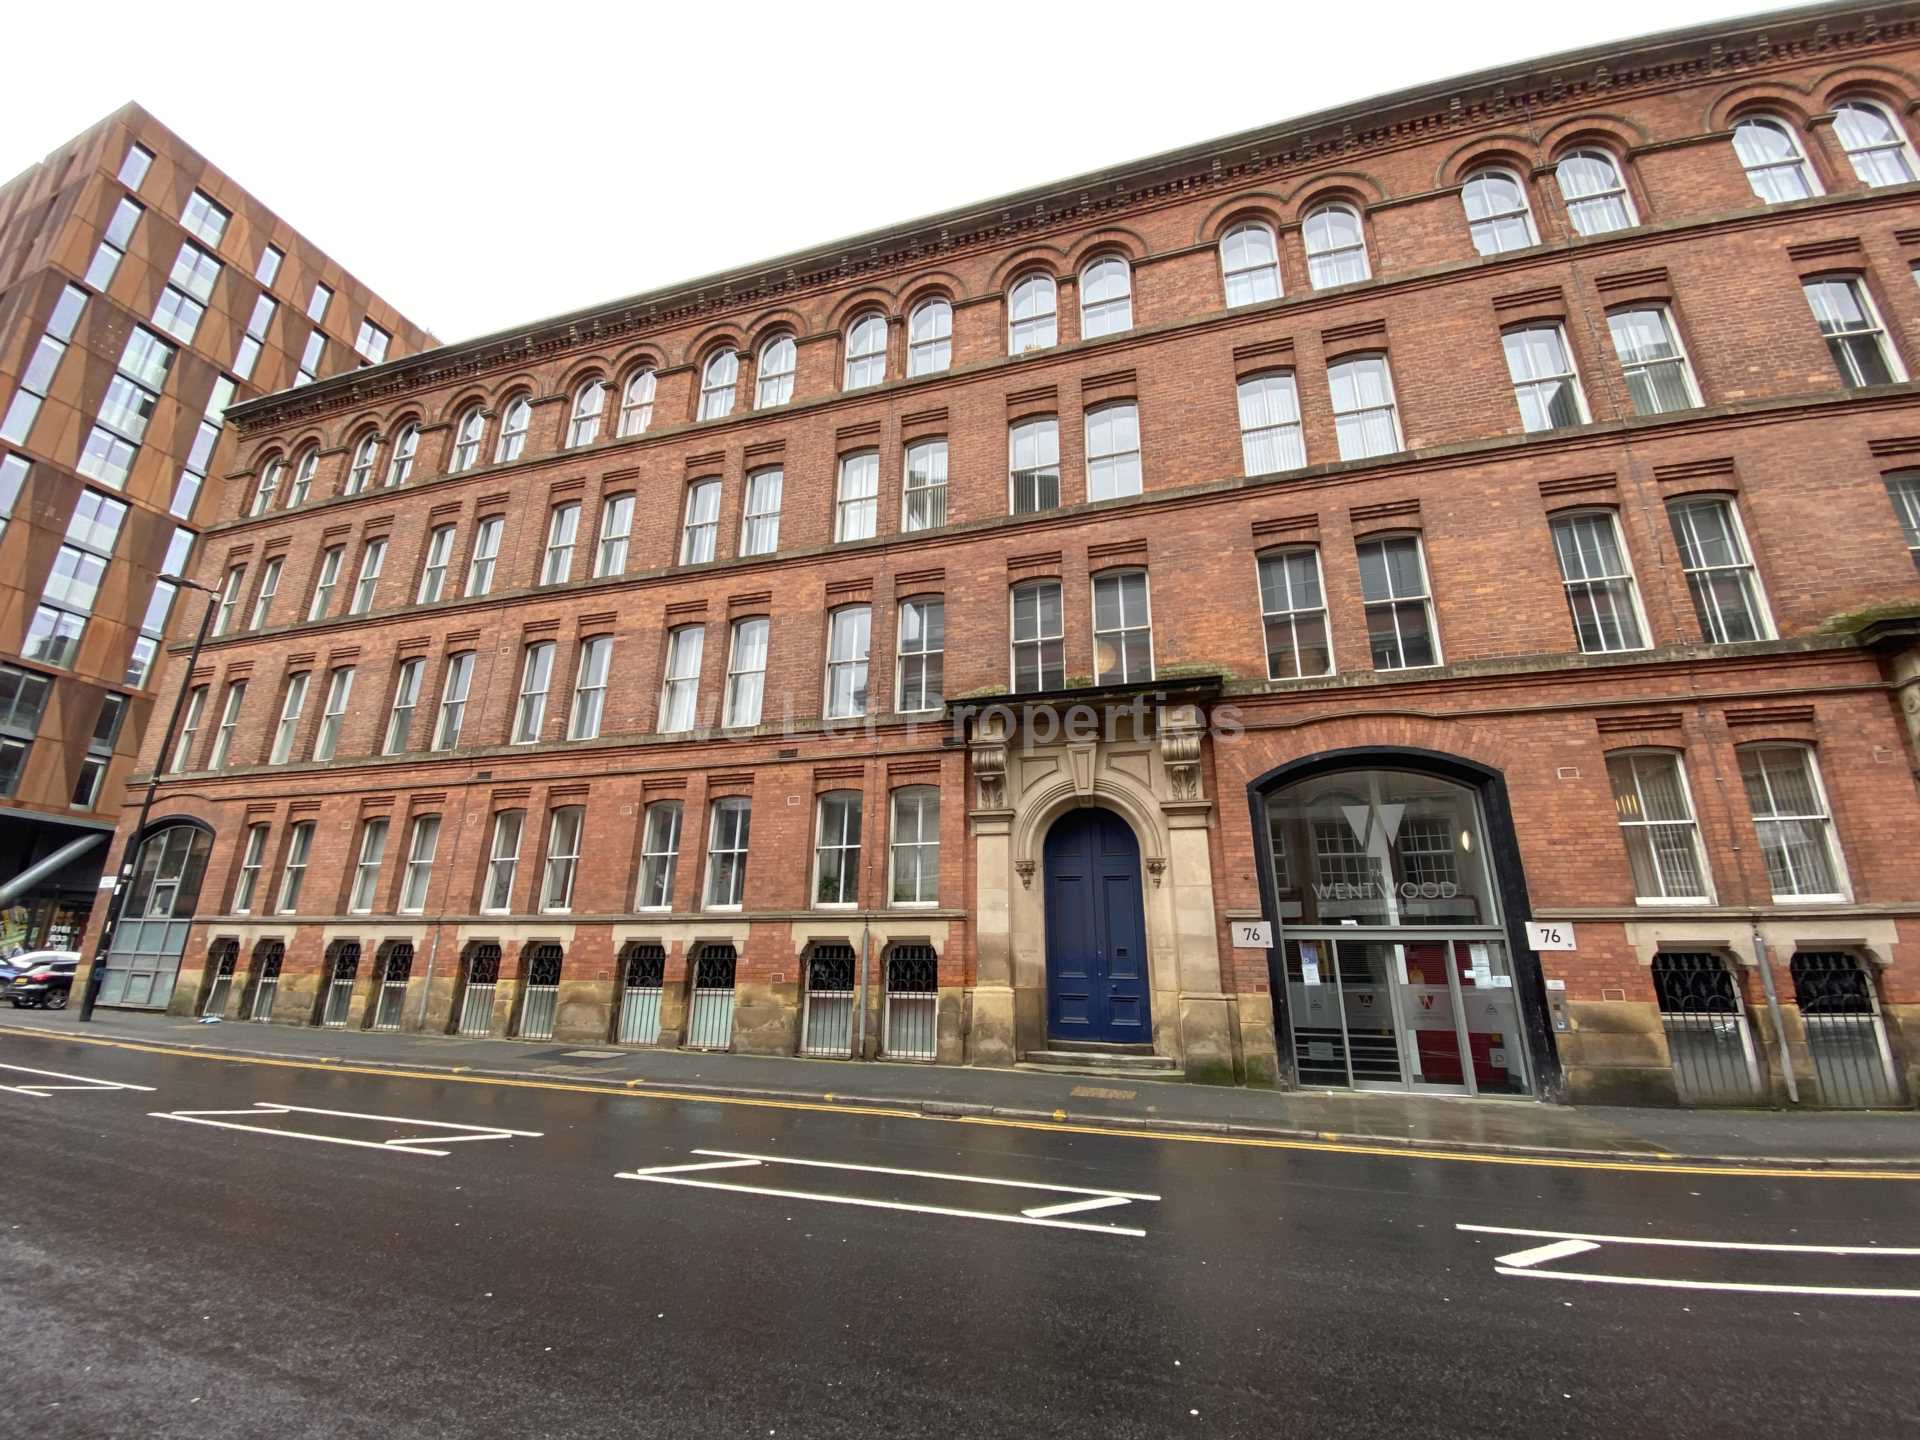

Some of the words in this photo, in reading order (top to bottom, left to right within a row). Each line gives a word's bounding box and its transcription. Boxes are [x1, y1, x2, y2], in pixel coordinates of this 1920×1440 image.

[1312, 881, 1457, 900] WENTWOOD
[1243, 927, 1260, 942] 76
[1540, 928, 1561, 944] 76
